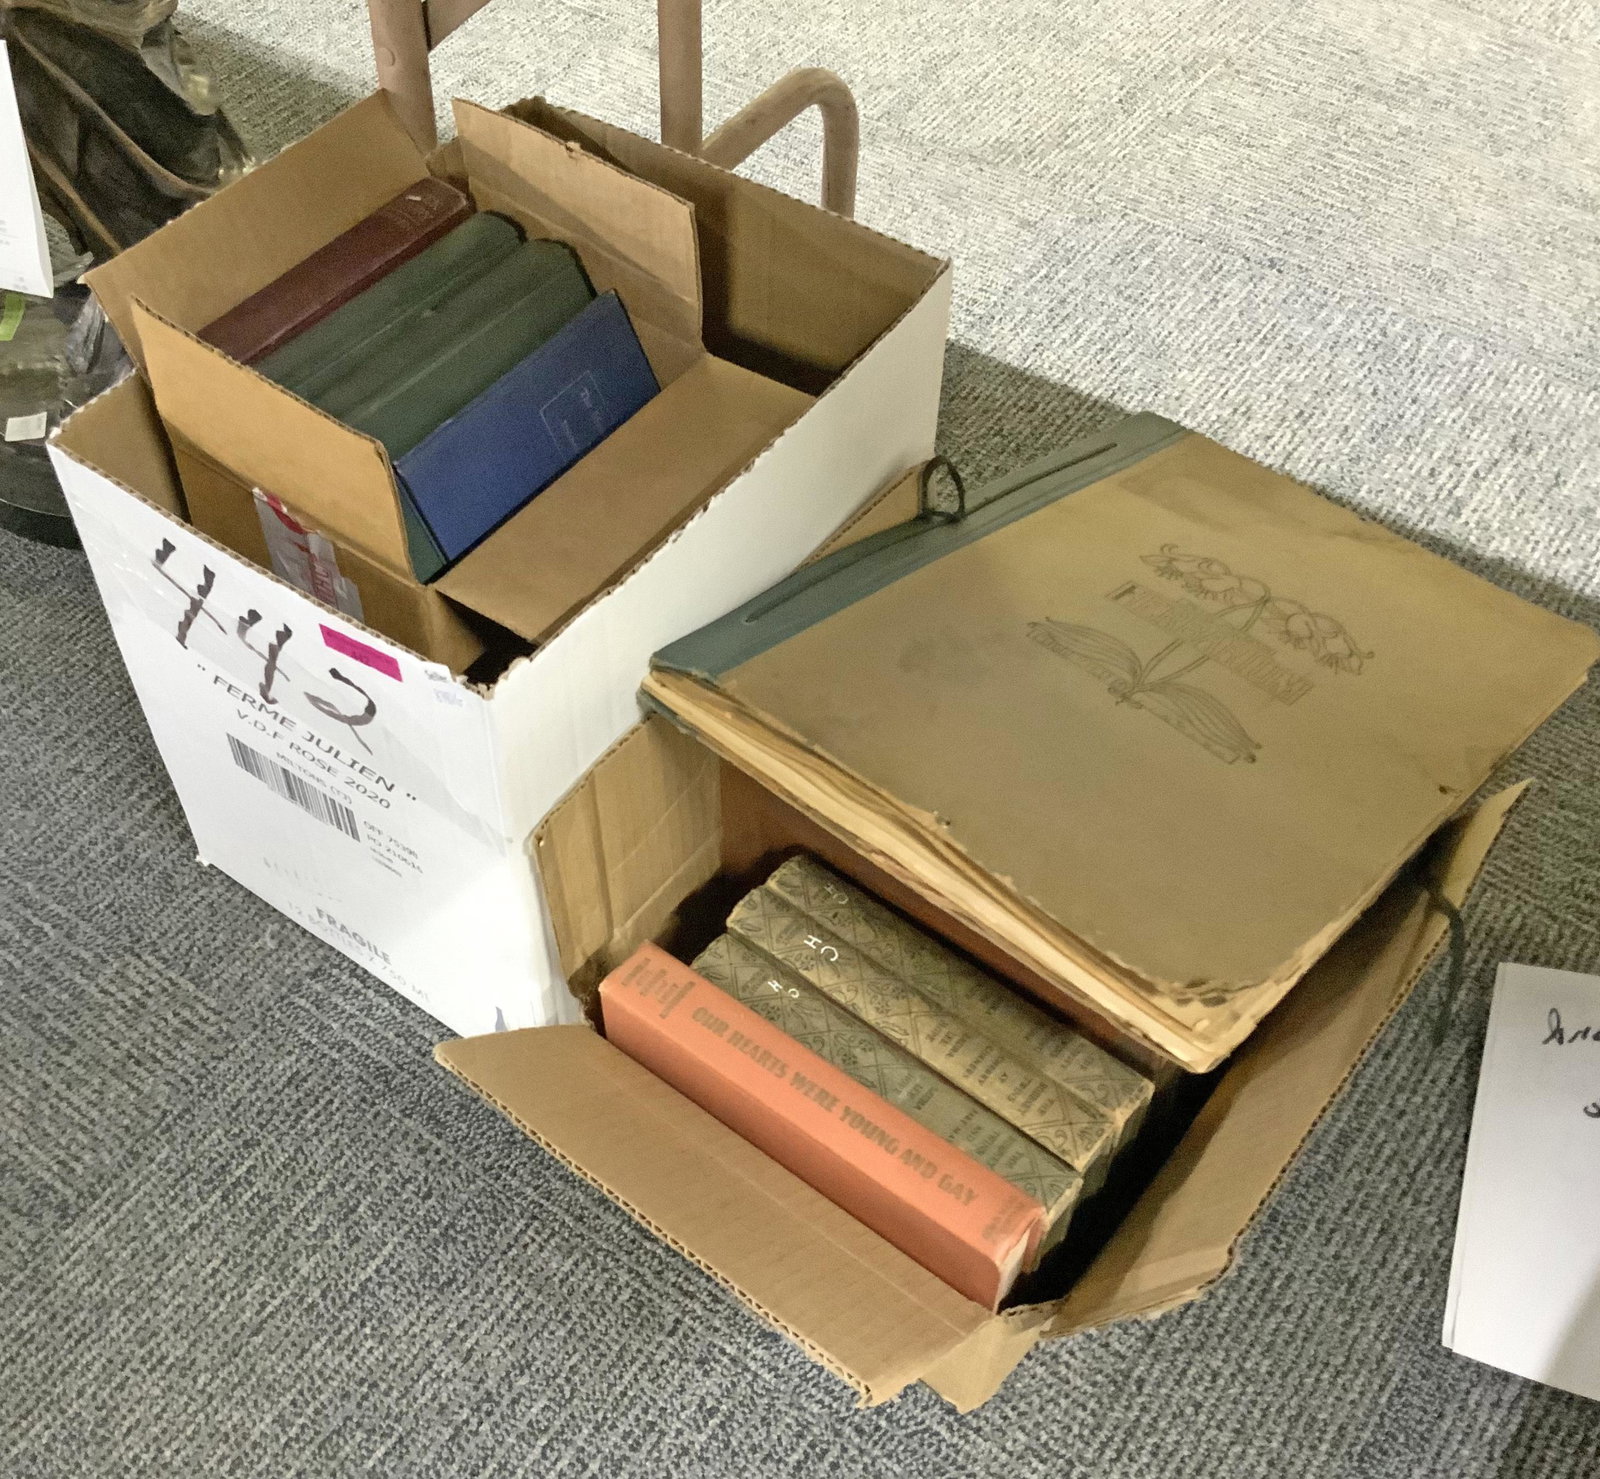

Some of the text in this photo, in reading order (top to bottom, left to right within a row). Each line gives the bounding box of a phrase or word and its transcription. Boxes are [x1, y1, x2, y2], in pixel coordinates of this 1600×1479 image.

[213, 674, 297, 732] FERME
[301, 730, 396, 793] JULIEN
[289, 742, 338, 778] ROSE
[344, 776, 392, 810] 2020
[315, 906, 392, 966] FRAGILE
[691, 1007, 977, 1207] OUR HEARTS WERE YOUNG AND GAY
